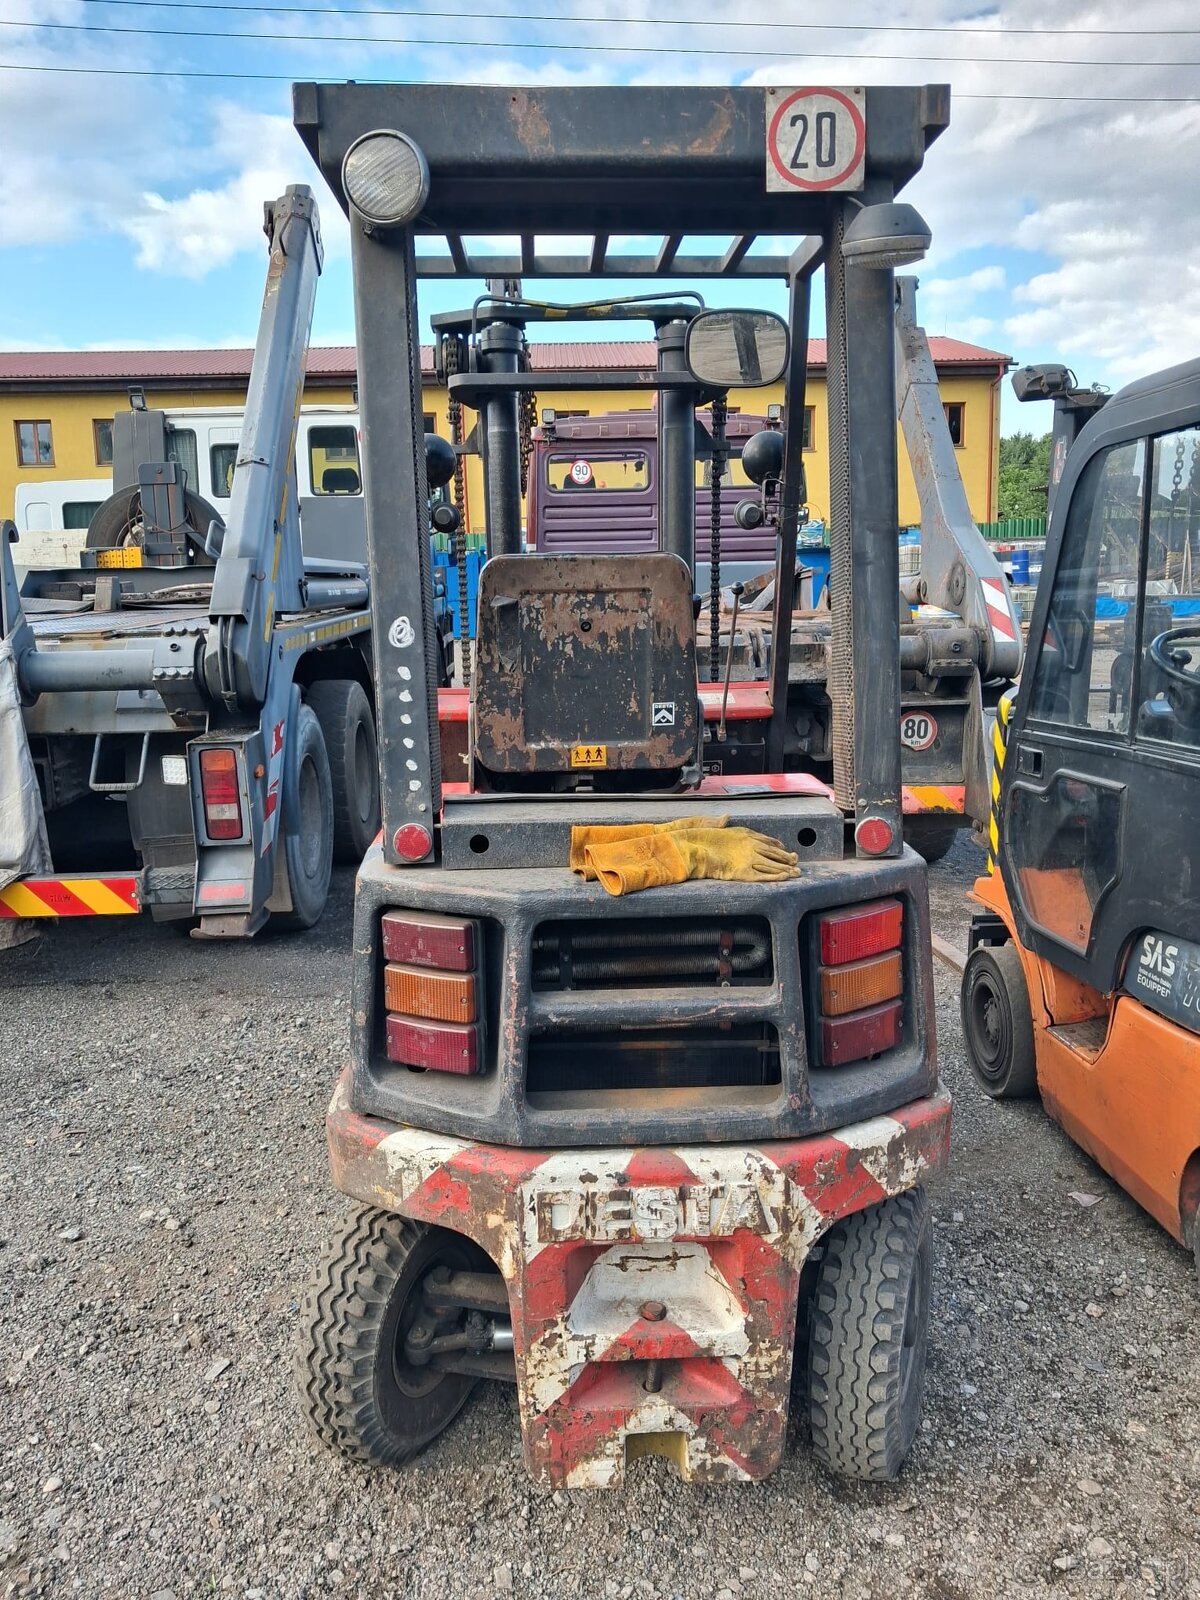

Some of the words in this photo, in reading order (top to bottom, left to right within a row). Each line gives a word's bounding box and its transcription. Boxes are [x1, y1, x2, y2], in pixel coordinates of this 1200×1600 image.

[789, 111, 837, 169] 20
[574, 464, 588, 476] 90
[903, 718, 929, 739] 80
[1140, 934, 1179, 977] SAS
[537, 1184, 772, 1243] DESTA
